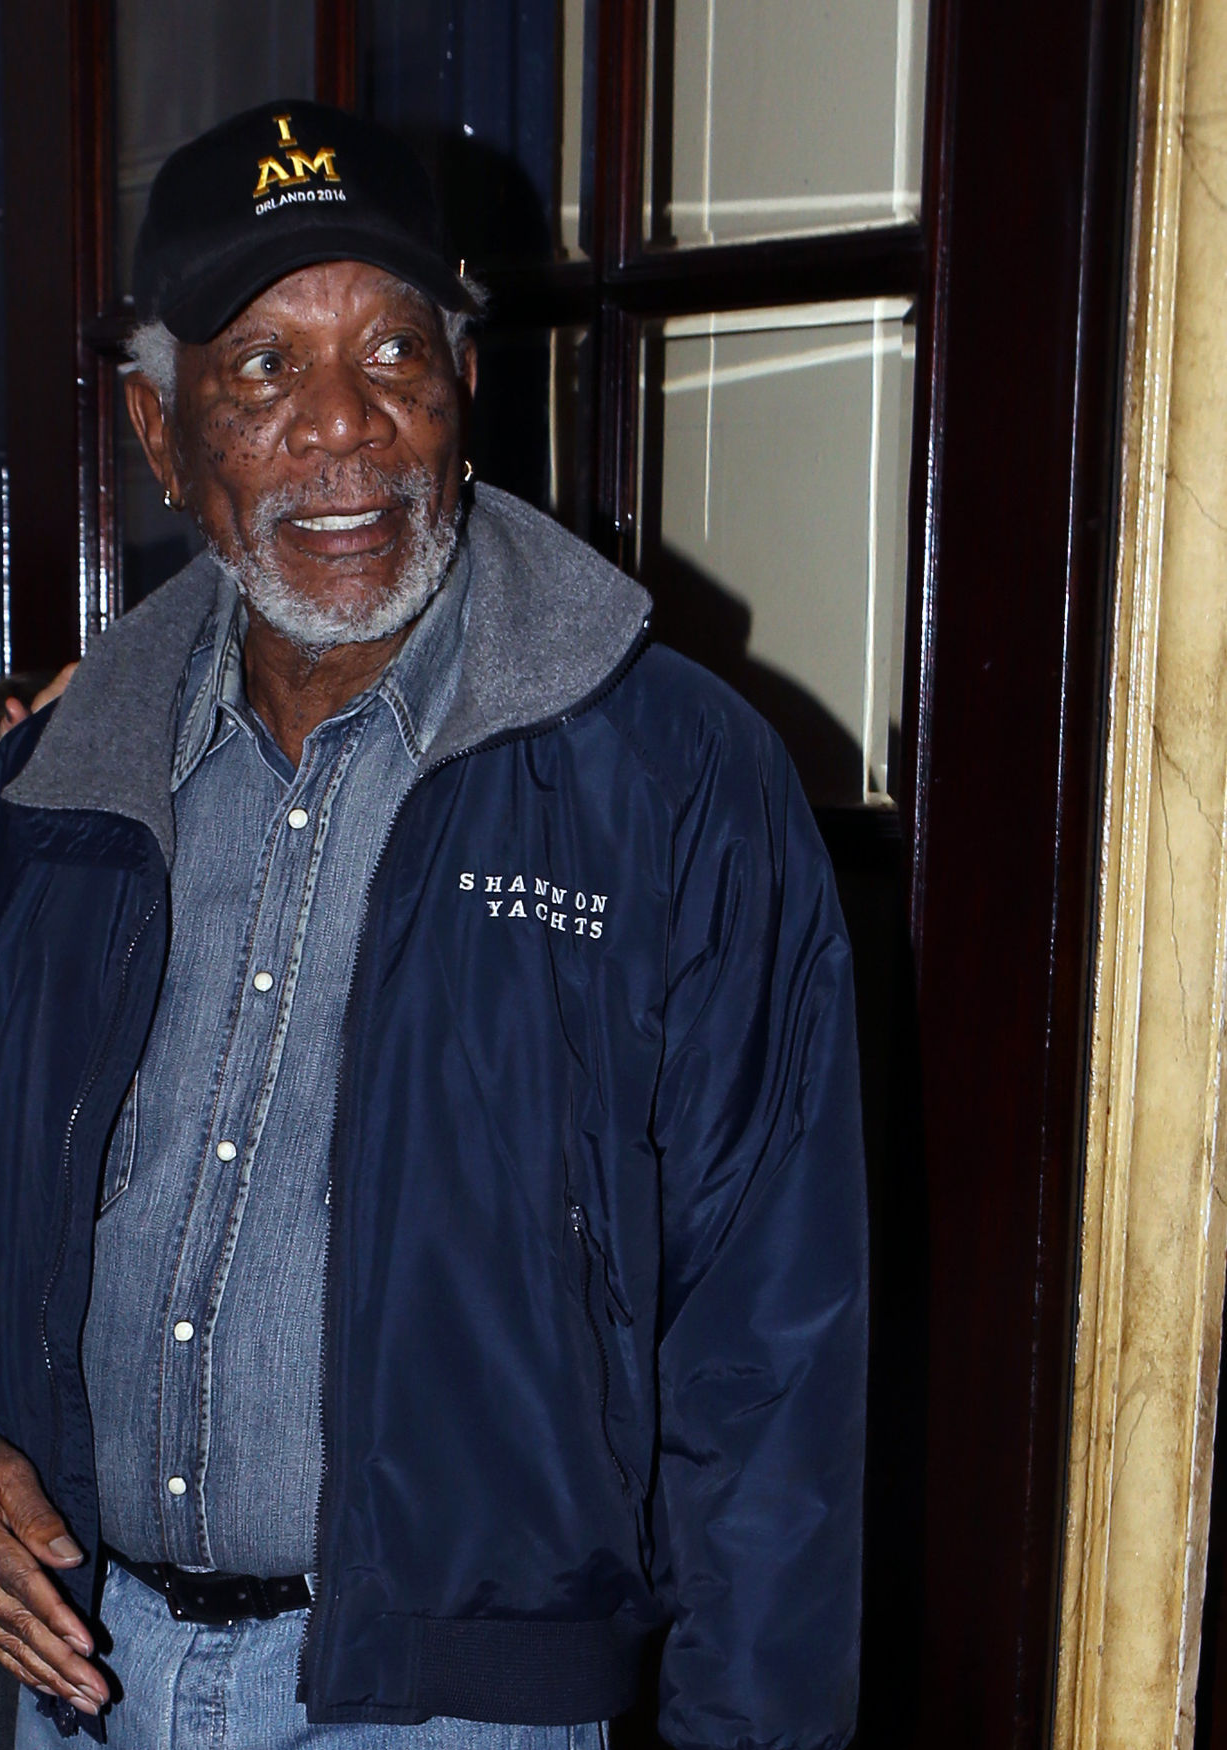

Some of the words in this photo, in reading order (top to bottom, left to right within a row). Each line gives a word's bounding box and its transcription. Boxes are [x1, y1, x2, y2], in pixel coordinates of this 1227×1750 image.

[273, 113, 297, 147] I
[253, 147, 341, 199] AM
[255, 191, 315, 215] ORLANDO
[316, 189, 347, 202] 2016
[459, 873, 608, 913] SHANNON
[486, 899, 603, 939] YACHTS
